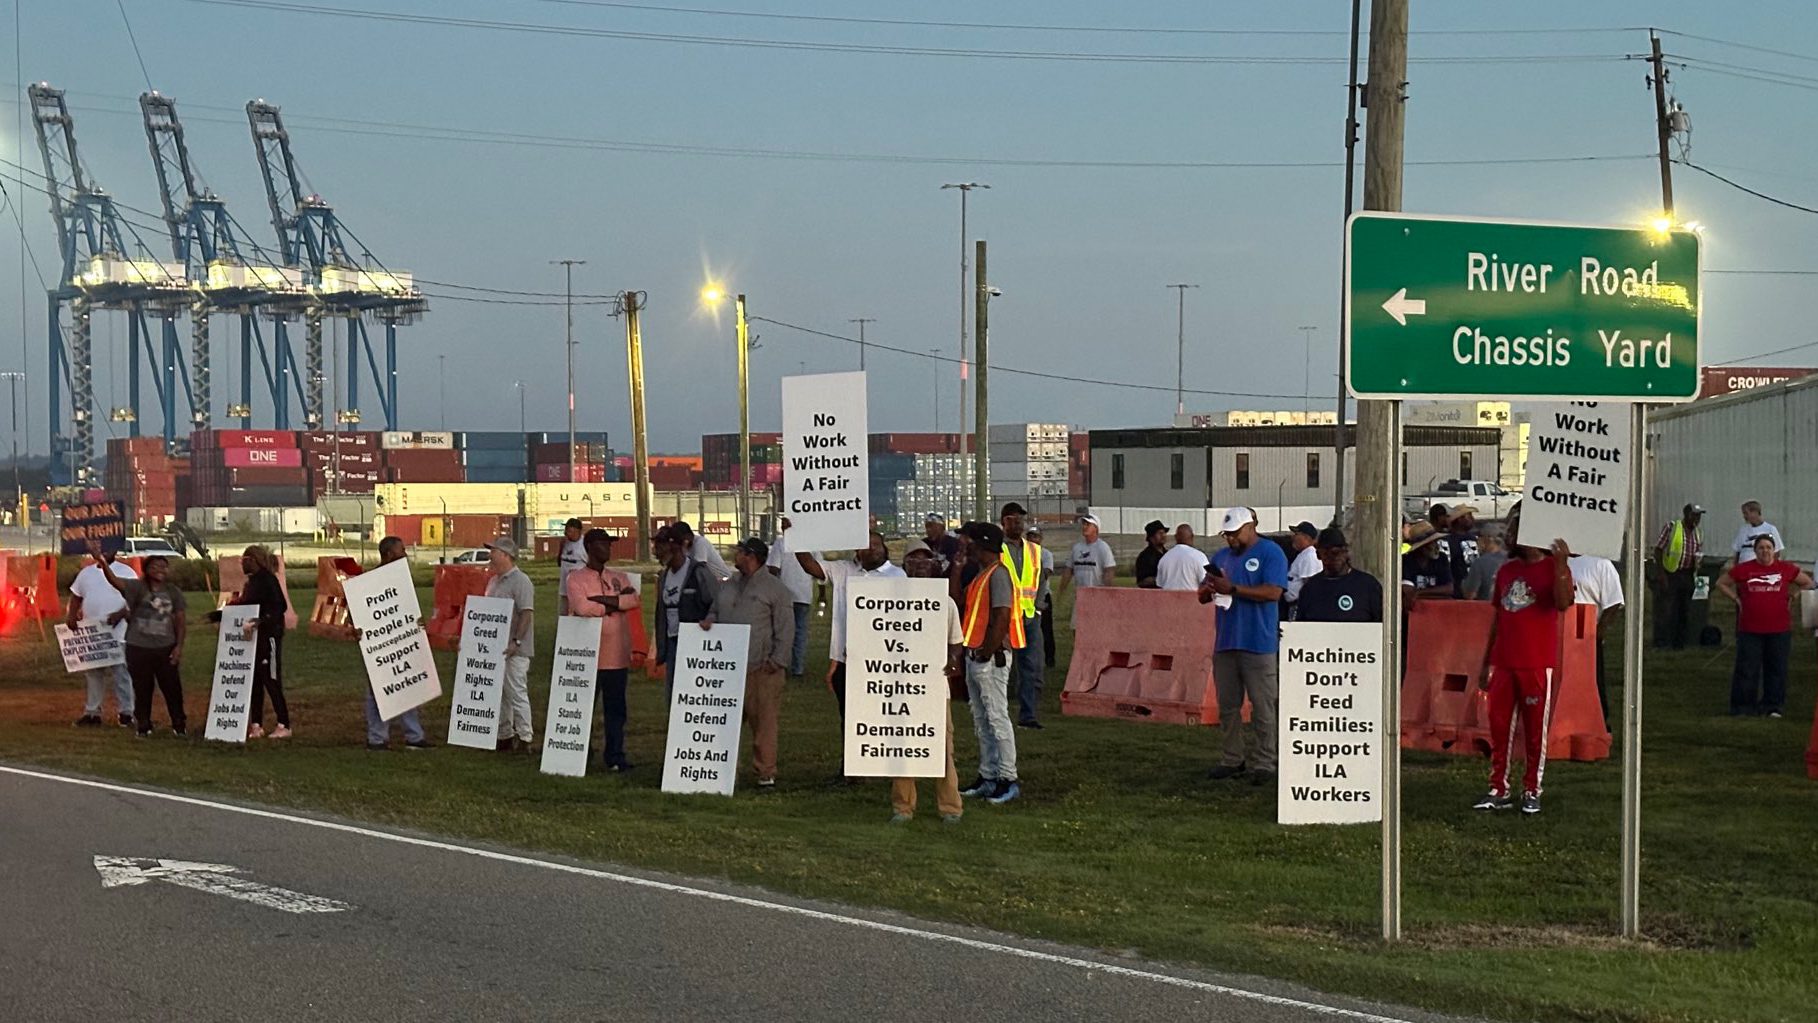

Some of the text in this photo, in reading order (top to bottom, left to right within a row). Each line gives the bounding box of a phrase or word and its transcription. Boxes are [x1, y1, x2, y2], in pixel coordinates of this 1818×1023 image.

[1468, 252, 1658, 296] River Road
[1453, 326, 1671, 368] Chassis Yard
[814, 413, 835, 427] No
[1555, 413, 1608, 436] Work
[803, 433, 847, 448] Work
[250, 451, 277, 461] ONE
[1539, 436, 1620, 463] Without
[792, 455, 859, 470] Without
[1548, 463, 1606, 485] A Fair
[802, 475, 849, 491] A Fair
[792, 497, 861, 513] Contract
[1532, 486, 1617, 513] Contract
[366, 587, 398, 607] Profit
[373, 604, 400, 620] Over
[855, 596, 941, 614] Corporate
[468, 610, 508, 624] Corporate
[365, 614, 414, 640] People Is
[473, 626, 497, 638] Greed
[872, 618, 922, 632] Greed
[229, 647, 244, 656] Over
[478, 643, 489, 653] Vs.
[558, 646, 596, 658] Automation
[702, 640, 723, 651] ILA
[884, 639, 909, 653] Vs.
[375, 640, 420, 666] Support
[1288, 648, 1376, 663] Machines
[219, 661, 251, 670] Machines:
[392, 661, 412, 676] ILA
[467, 658, 496, 670] Worker
[565, 660, 585, 672] Hurts
[686, 657, 736, 671] Workers
[865, 659, 929, 674] Worker
[222, 675, 245, 685] Defend
[382, 671, 428, 696] Workers
[465, 673, 493, 687] Rights:
[558, 676, 589, 688] Families:
[695, 676, 724, 688] Over
[1305, 671, 1358, 686] Don’t
[225, 690, 238, 699] Our
[470, 691, 484, 701] ILA
[866, 681, 926, 698] Rights:
[566, 693, 578, 703] ILA
[678, 693, 737, 707] Machines:
[1309, 694, 1353, 709] Feed
[214, 704, 244, 713] Jobs And
[456, 704, 495, 719] Demands
[558, 708, 582, 719] Stands
[881, 702, 910, 716] ILA
[216, 718, 238, 730] Rights
[684, 712, 727, 725] Defend
[1289, 717, 1374, 733] Families:
[457, 720, 490, 734] Fairness
[556, 723, 581, 735] For Job
[856, 723, 935, 737] Demands
[692, 730, 715, 743] Our
[548, 738, 584, 751] Protection
[861, 743, 930, 758] Fairness
[1292, 740, 1370, 759] Support
[674, 748, 728, 762] Jobs And
[680, 766, 718, 781] Rights
[1315, 764, 1347, 778] ILA
[1291, 786, 1371, 802] Workers
